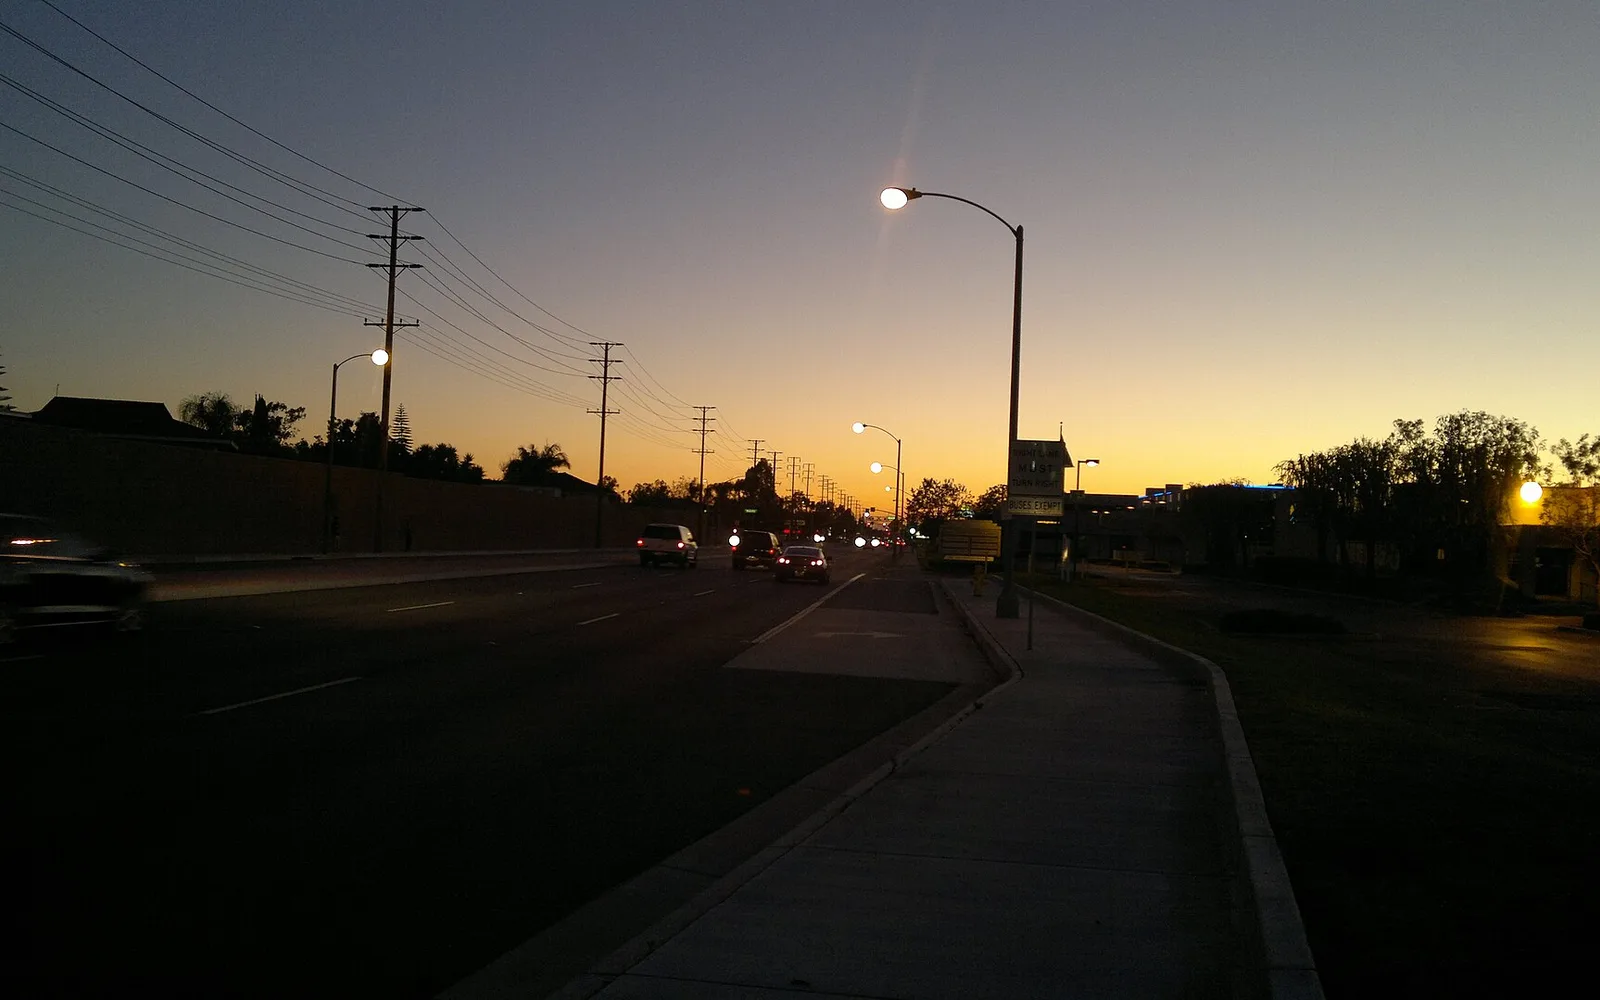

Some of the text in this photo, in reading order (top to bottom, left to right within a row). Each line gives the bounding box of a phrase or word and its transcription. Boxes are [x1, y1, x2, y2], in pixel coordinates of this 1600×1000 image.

[1018, 464, 1053, 473] MUST
[1012, 479, 1061, 489] TURN RIGHT
[1009, 500, 1061, 511] BUSES EXEMPT
